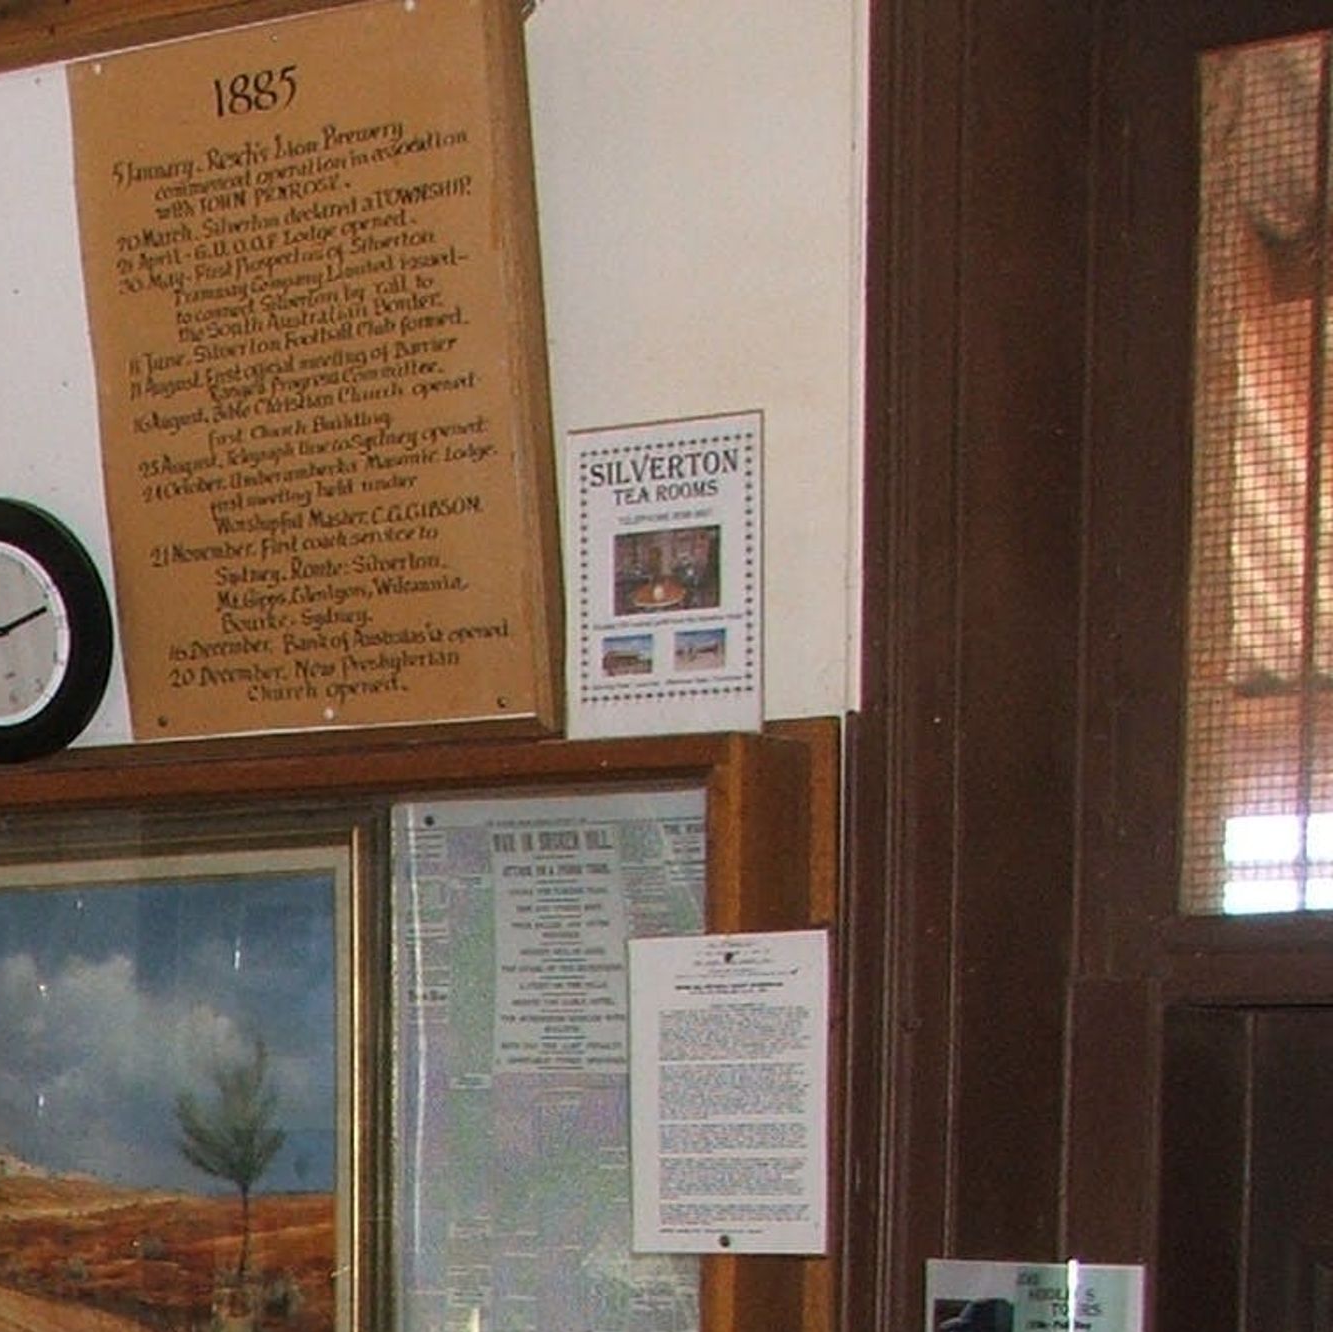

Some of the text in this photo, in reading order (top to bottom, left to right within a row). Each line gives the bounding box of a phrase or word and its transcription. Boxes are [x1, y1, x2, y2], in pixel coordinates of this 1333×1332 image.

[213, 64, 299, 118] 1885
[275, 122, 403, 158] Lion Brewery
[255, 155, 348, 184] operation
[371, 130, 468, 162] association
[202, 196, 357, 238] Silverton declared
[350, 232, 434, 253] Silverton
[415, 275, 433, 288] to
[338, 382, 403, 403] Church
[590, 448, 740, 488] SILVERTON
[613, 480, 719, 506] TEA ROOMS
[294, 659, 336, 682] New
[247, 679, 318, 702] Church
